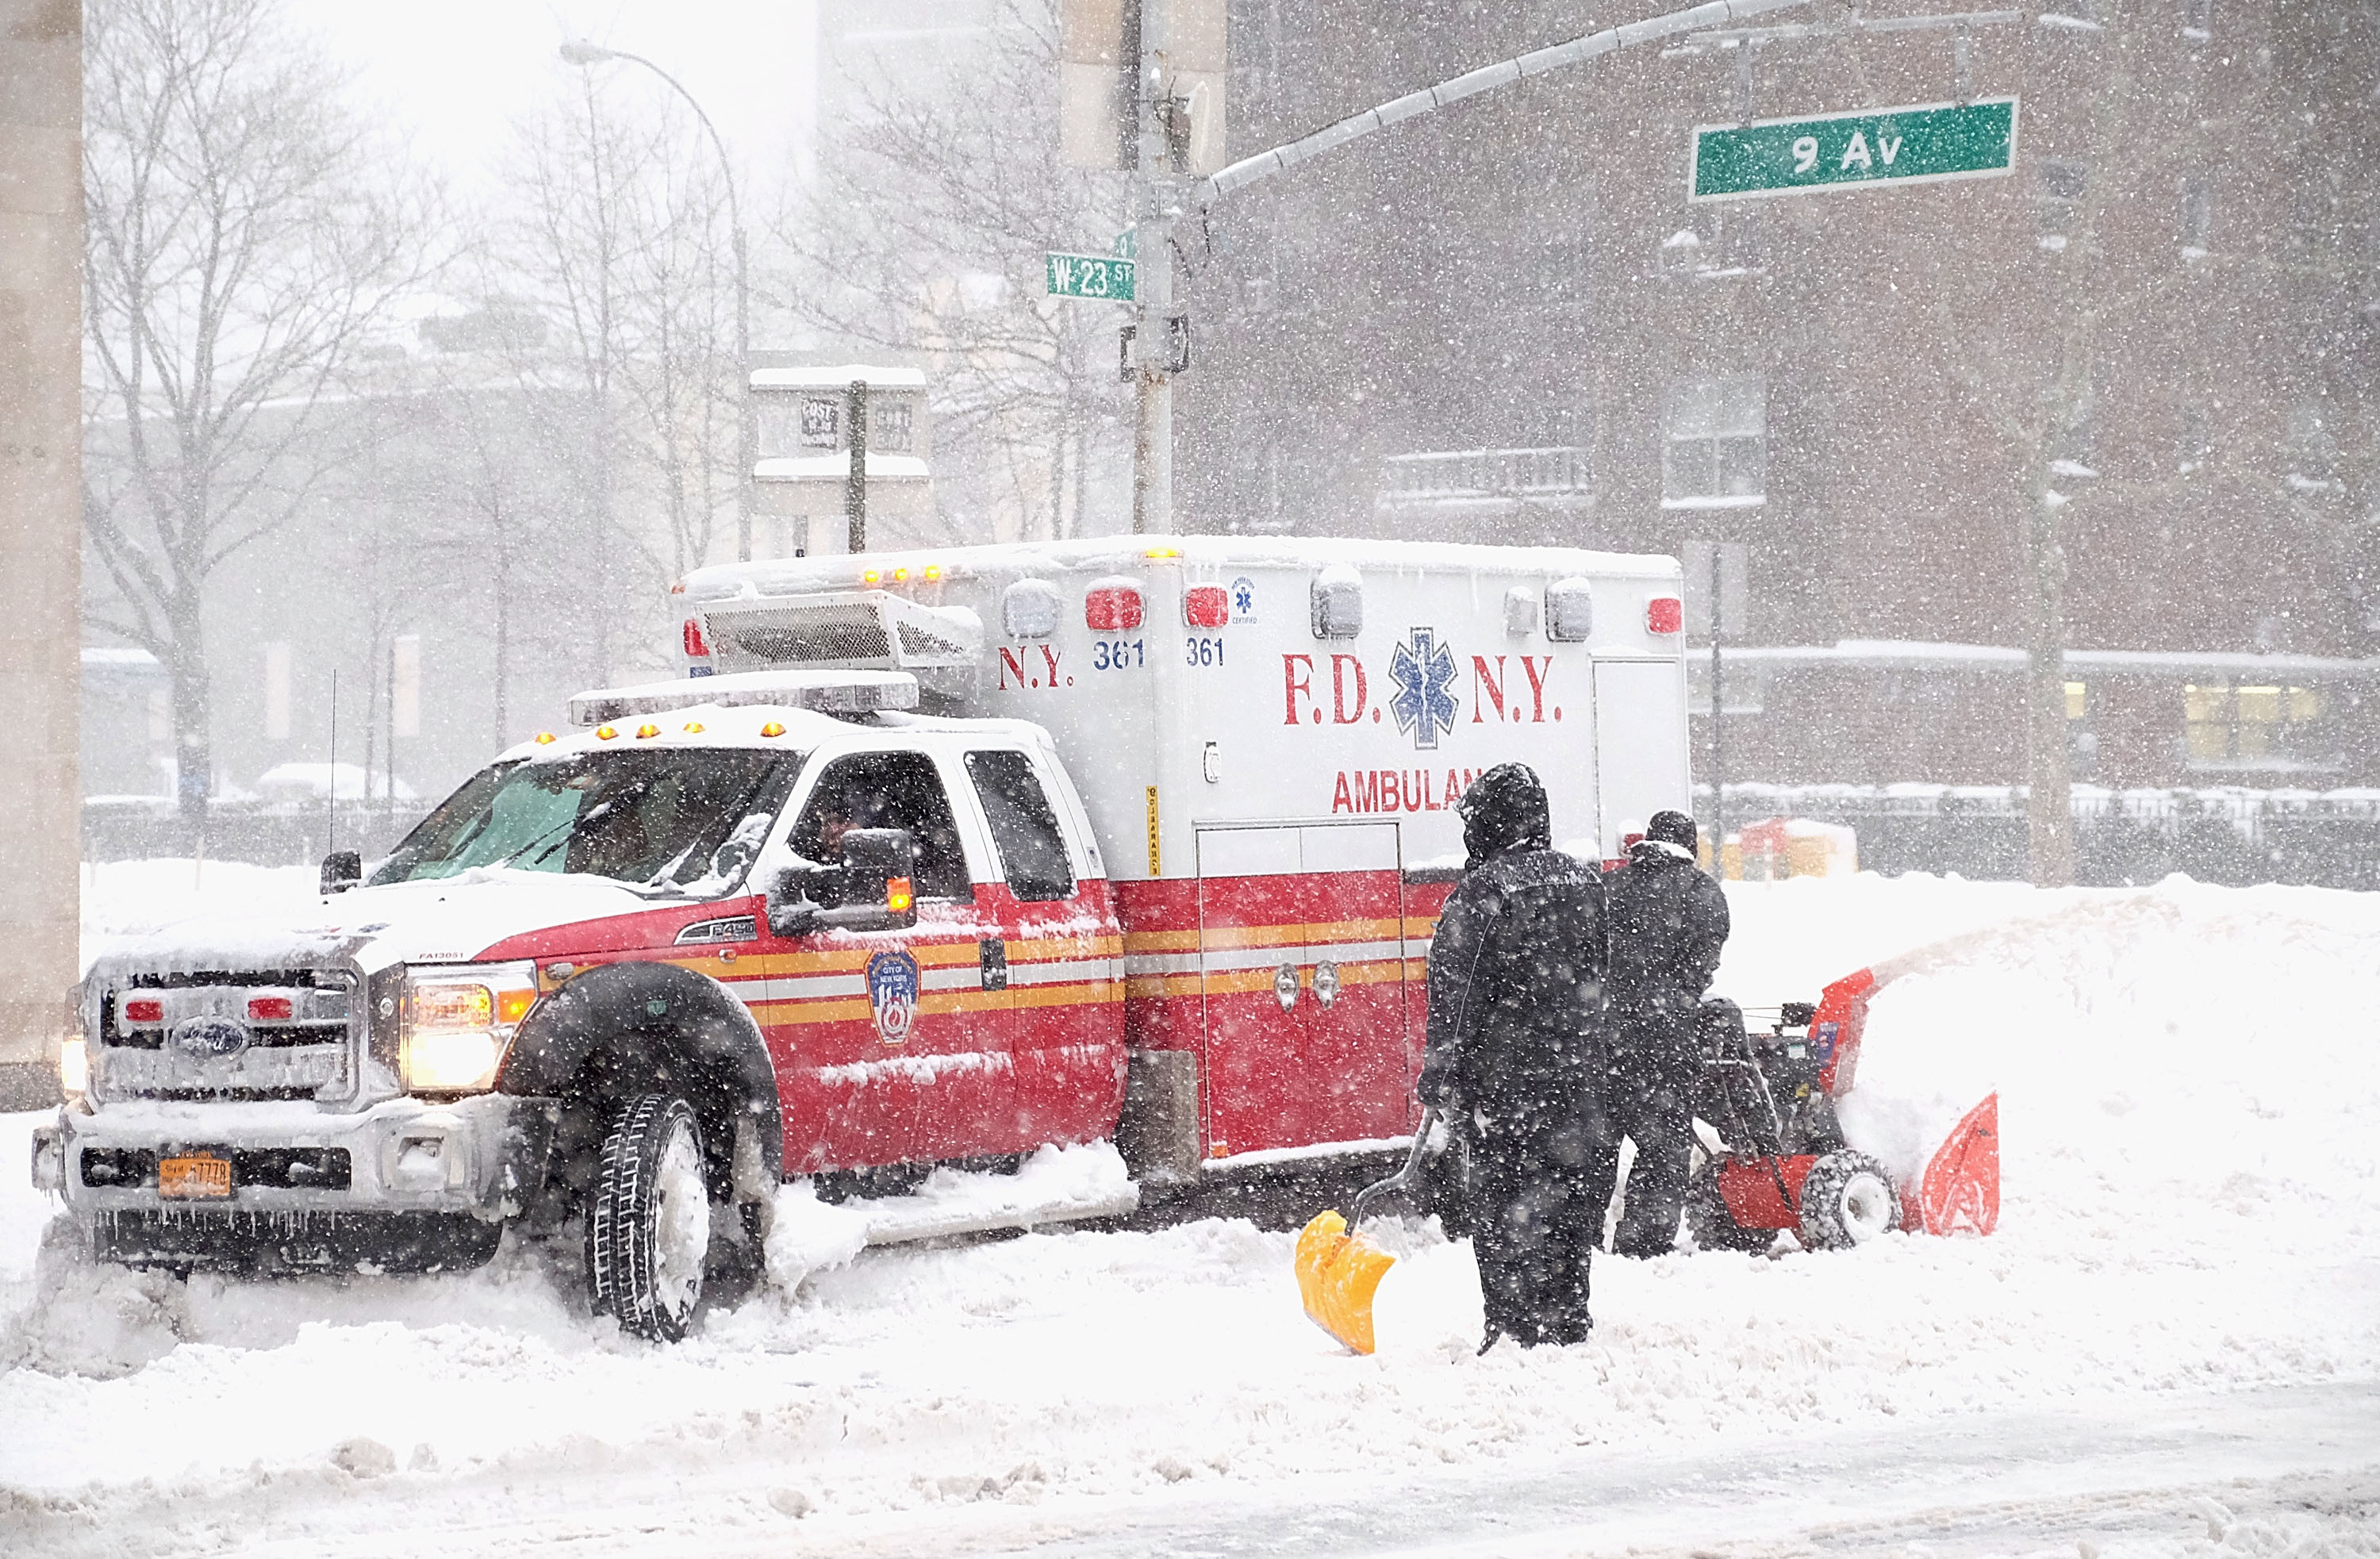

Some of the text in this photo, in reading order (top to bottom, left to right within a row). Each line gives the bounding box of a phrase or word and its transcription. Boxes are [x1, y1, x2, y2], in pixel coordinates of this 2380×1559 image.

[1792, 132, 1903, 174] 9 Av
[1079, 259, 1108, 296] 23
[1114, 263, 1133, 282] ST
[998, 644, 1074, 690] N.Y.
[1093, 639, 1144, 670] 361
[1187, 638, 1223, 666] 361
[1281, 653, 1562, 725] F.D. N.Y.
